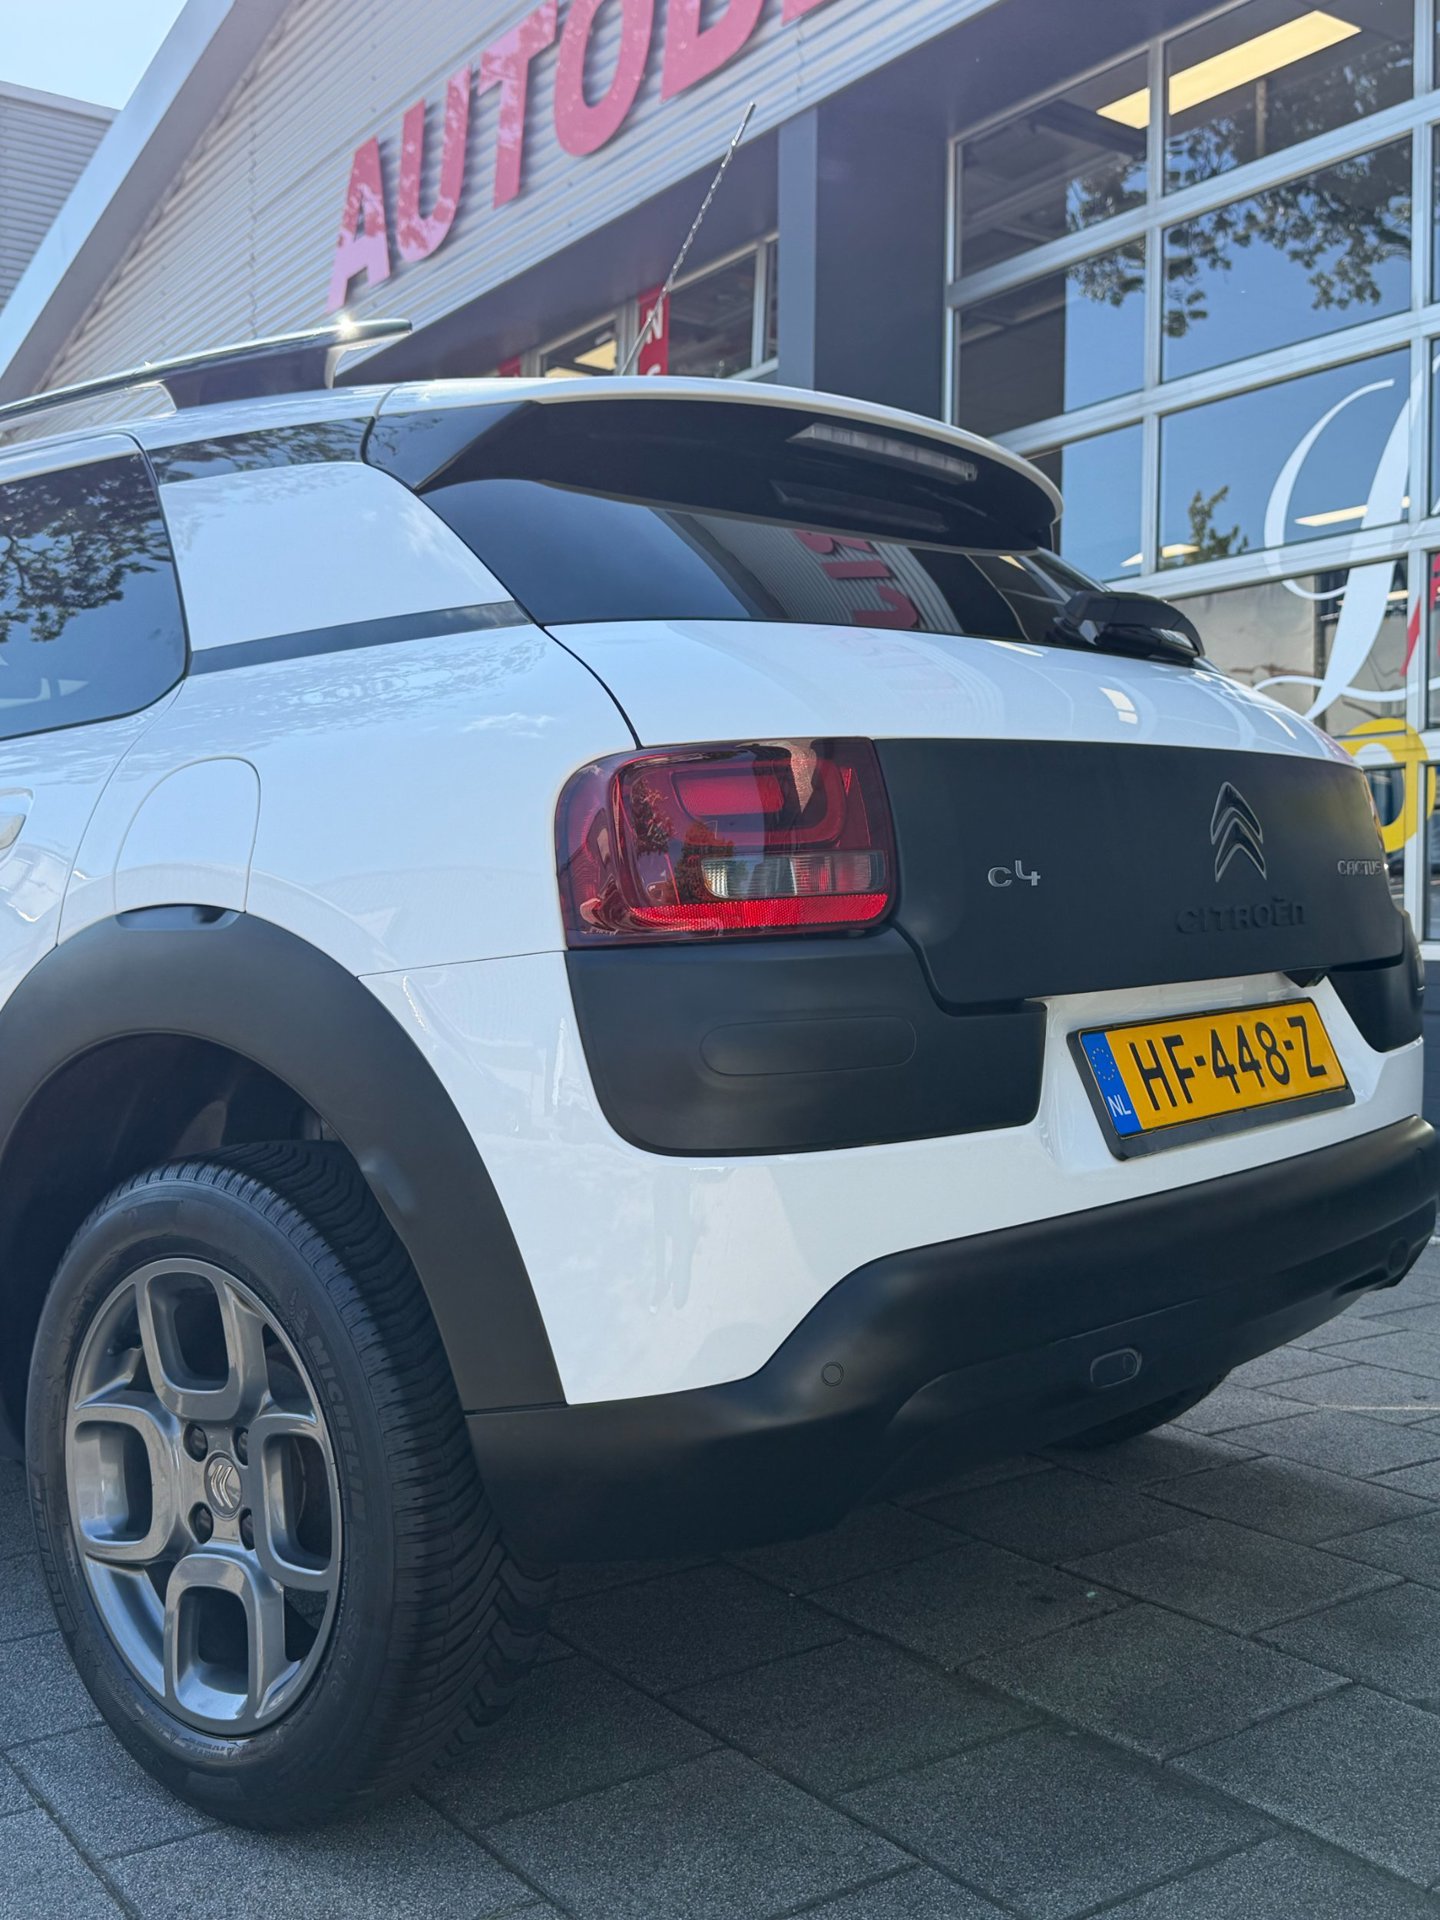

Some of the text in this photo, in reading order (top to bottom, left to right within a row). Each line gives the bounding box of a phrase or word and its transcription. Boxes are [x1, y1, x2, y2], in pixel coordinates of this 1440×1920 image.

[988, 860, 1041, 888] C4
[1337, 860, 1382, 876] CACTUS
[1129, 1016, 1327, 1110] HF-448-Z
[1107, 1094, 1132, 1118] NL
